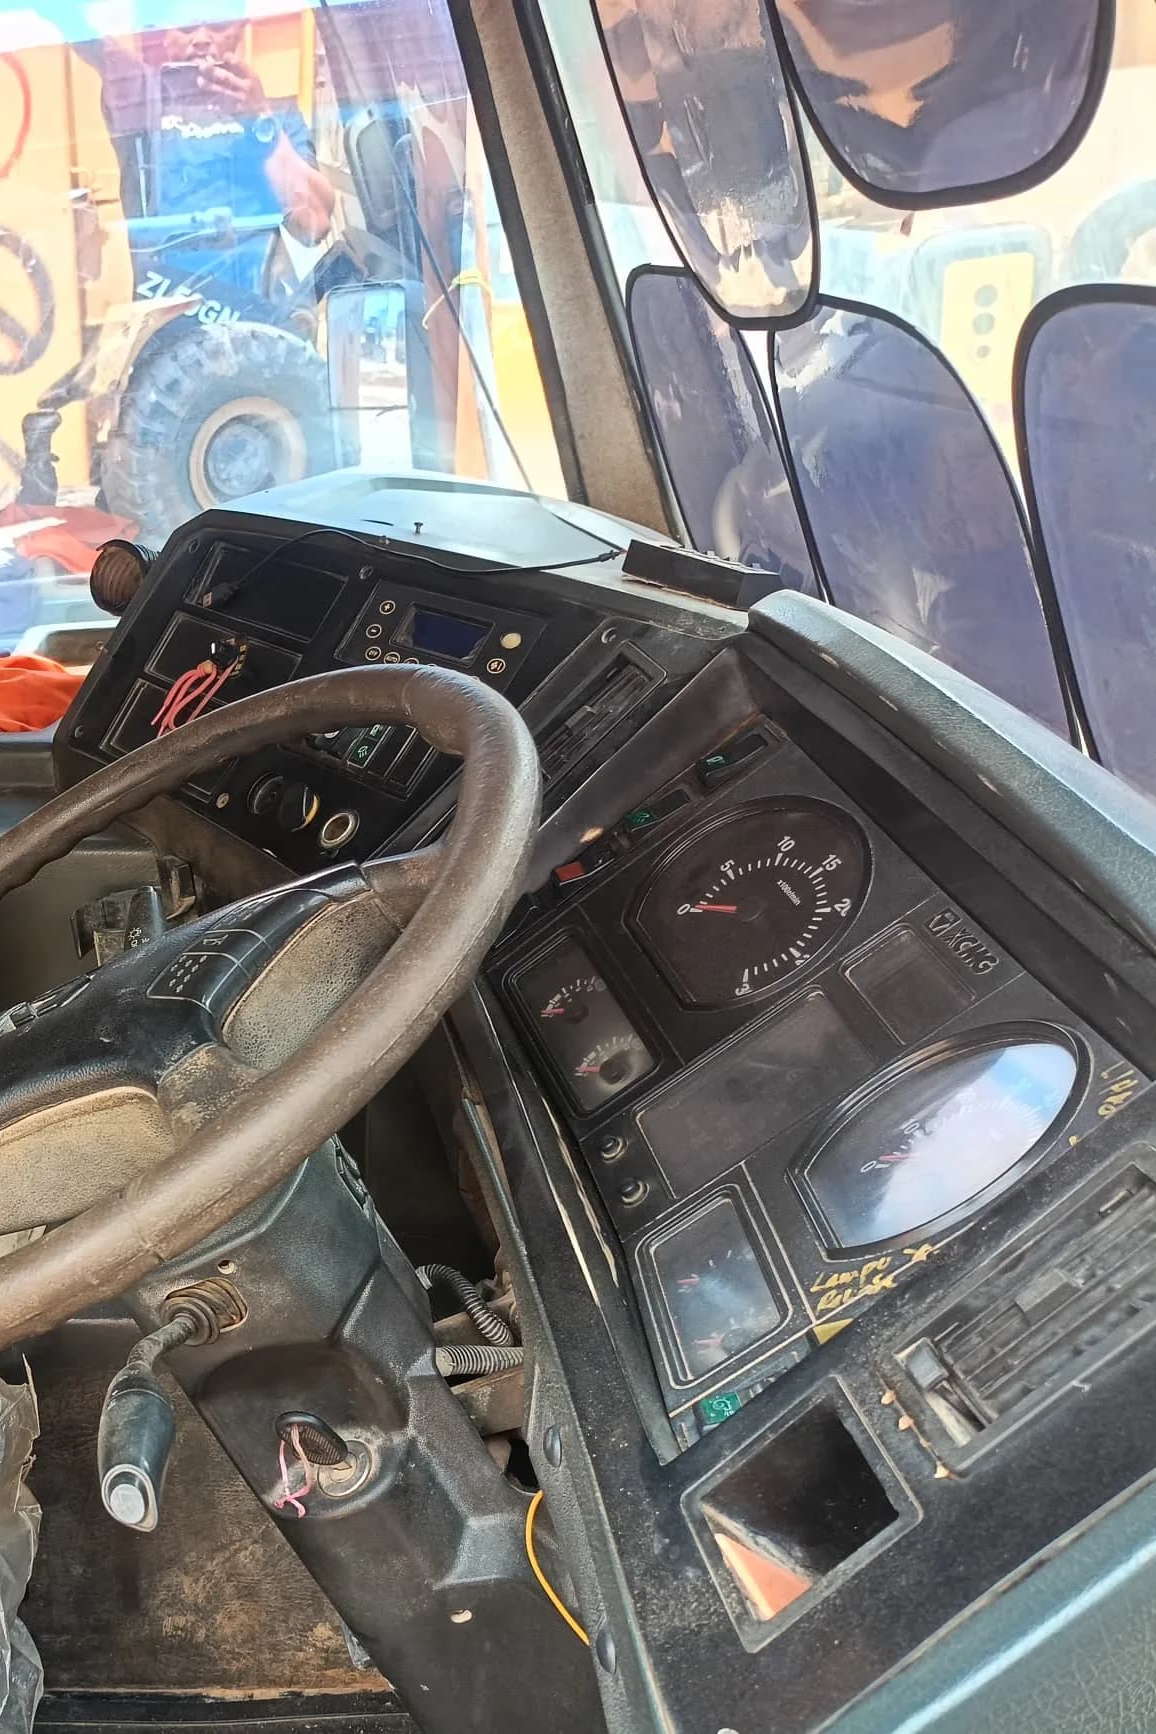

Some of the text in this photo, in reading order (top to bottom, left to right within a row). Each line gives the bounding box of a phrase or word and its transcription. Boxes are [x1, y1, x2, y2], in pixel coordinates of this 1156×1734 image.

[776, 836, 795, 852] 10
[720, 859, 735, 872] 5
[822, 854, 842, 872] 15
[676, 903, 691, 916] 0
[938, 924, 1000, 976] XCMG
[860, 1160, 877, 1174] 0
